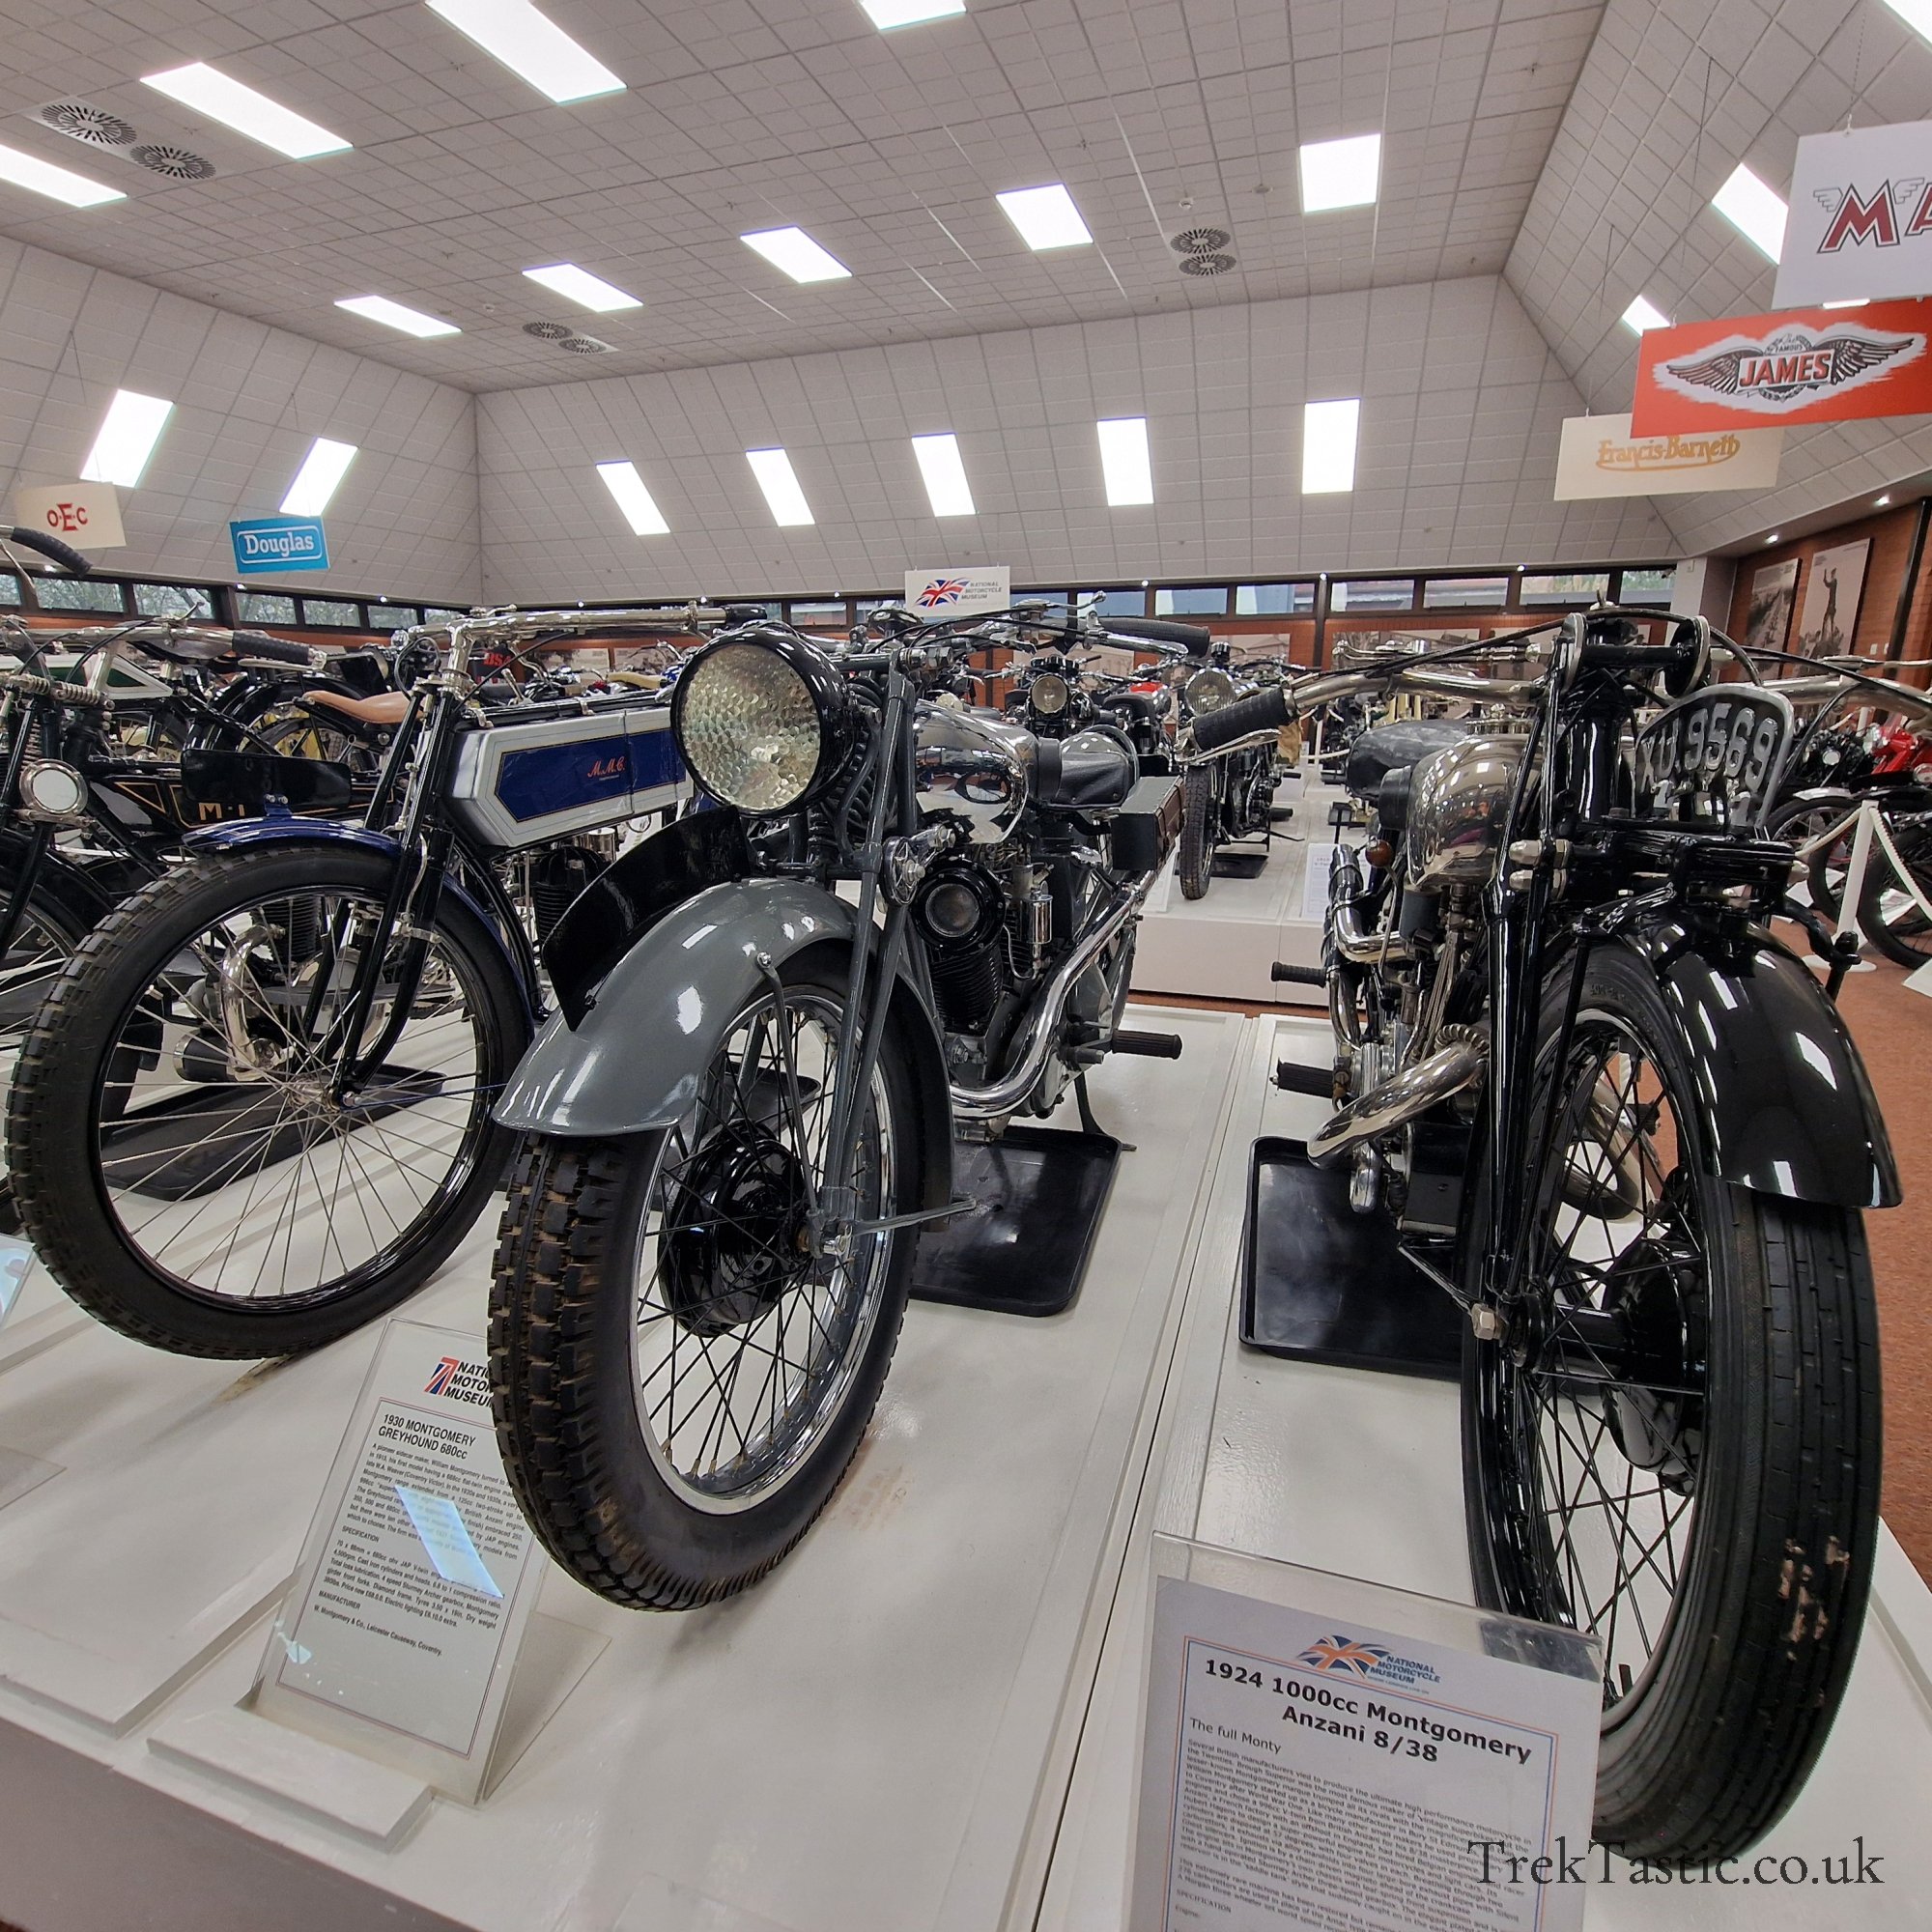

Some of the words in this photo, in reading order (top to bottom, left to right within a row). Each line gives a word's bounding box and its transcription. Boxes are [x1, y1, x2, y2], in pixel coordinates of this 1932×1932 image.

[1739, 353, 1832, 387] JAMES
[1596, 435, 1741, 471] Francis-Barnett
[244, 531, 315, 558] Douglas
[377, 1424, 440, 1451] GREYHOUND
[439, 1442, 469, 1460] 680cc
[382, 1412, 406, 1428] 1930
[404, 1418, 477, 1447] MONTGOMERY
[361, 1467, 393, 1484] Montgomery
[393, 1478, 410, 1489] range
[407, 1462, 424, 1472] model
[422, 1466, 441, 1478] having
[482, 1484, 501, 1495] engine
[430, 1459, 449, 1469] William
[448, 1463, 481, 1480] Montgomery
[340, 1524, 381, 1543] SPECIFICATION
[317, 1589, 361, 1610] MANUFACTURER
[329, 1557, 343, 1566] Total
[384, 1577, 402, 1588] speed
[400, 1580, 424, 1595] Sturmey
[422, 1588, 442, 1601] Archer
[464, 1603, 499, 1621] Montgomery
[342, 1572, 355, 1582] front
[371, 1581, 396, 1595] Diamond
[413, 1596, 430, 1607] Tyres
[465, 1613, 476, 1624] Dry
[476, 1617, 497, 1631] weight
[379, 1564, 404, 1577] cylinders
[451, 1588, 488, 1605] compression
[319, 1606, 352, 1624] Montgomery
[366, 1622, 391, 1636] Leicester
[388, 1631, 418, 1648] Causeway,
[416, 1640, 443, 1657] Coventry.
[1370, 1666, 1415, 1684] MUSEUM
[1377, 1661, 1441, 1683] MOTORCYCLE
[1386, 1655, 1436, 1674] NATIONAL
[1204, 1658, 1264, 1690] 1924
[1271, 1676, 1360, 1716] 1000cc
[1366, 1701, 1532, 1766] Montgomery
[1189, 1718, 1213, 1734] The
[1217, 1724, 1238, 1741] full
[1239, 1731, 1282, 1755] Monty
[1281, 1703, 1366, 1743] Anzani
[1372, 1728, 1438, 1766] 8/38
[1187, 1739, 1214, 1752] Several
[1215, 1747, 1239, 1759] British
[1240, 1754, 1293, 1776] manufacturers
[1321, 1778, 1353, 1795] produce
[1354, 1787, 1369, 1798] the
[1370, 1792, 1403, 1808] ultimate
[1404, 1802, 1422, 1815] high
[1423, 1808, 1474, 1831] performance
[1475, 1823, 1521, 1845] motorcycle
[1235, 1768, 1280, 1789] Montgomery
[1264, 1769, 1295, 1786] Superior
[1350, 1795, 1378, 1809] famous
[1379, 1804, 1405, 1817] maker
